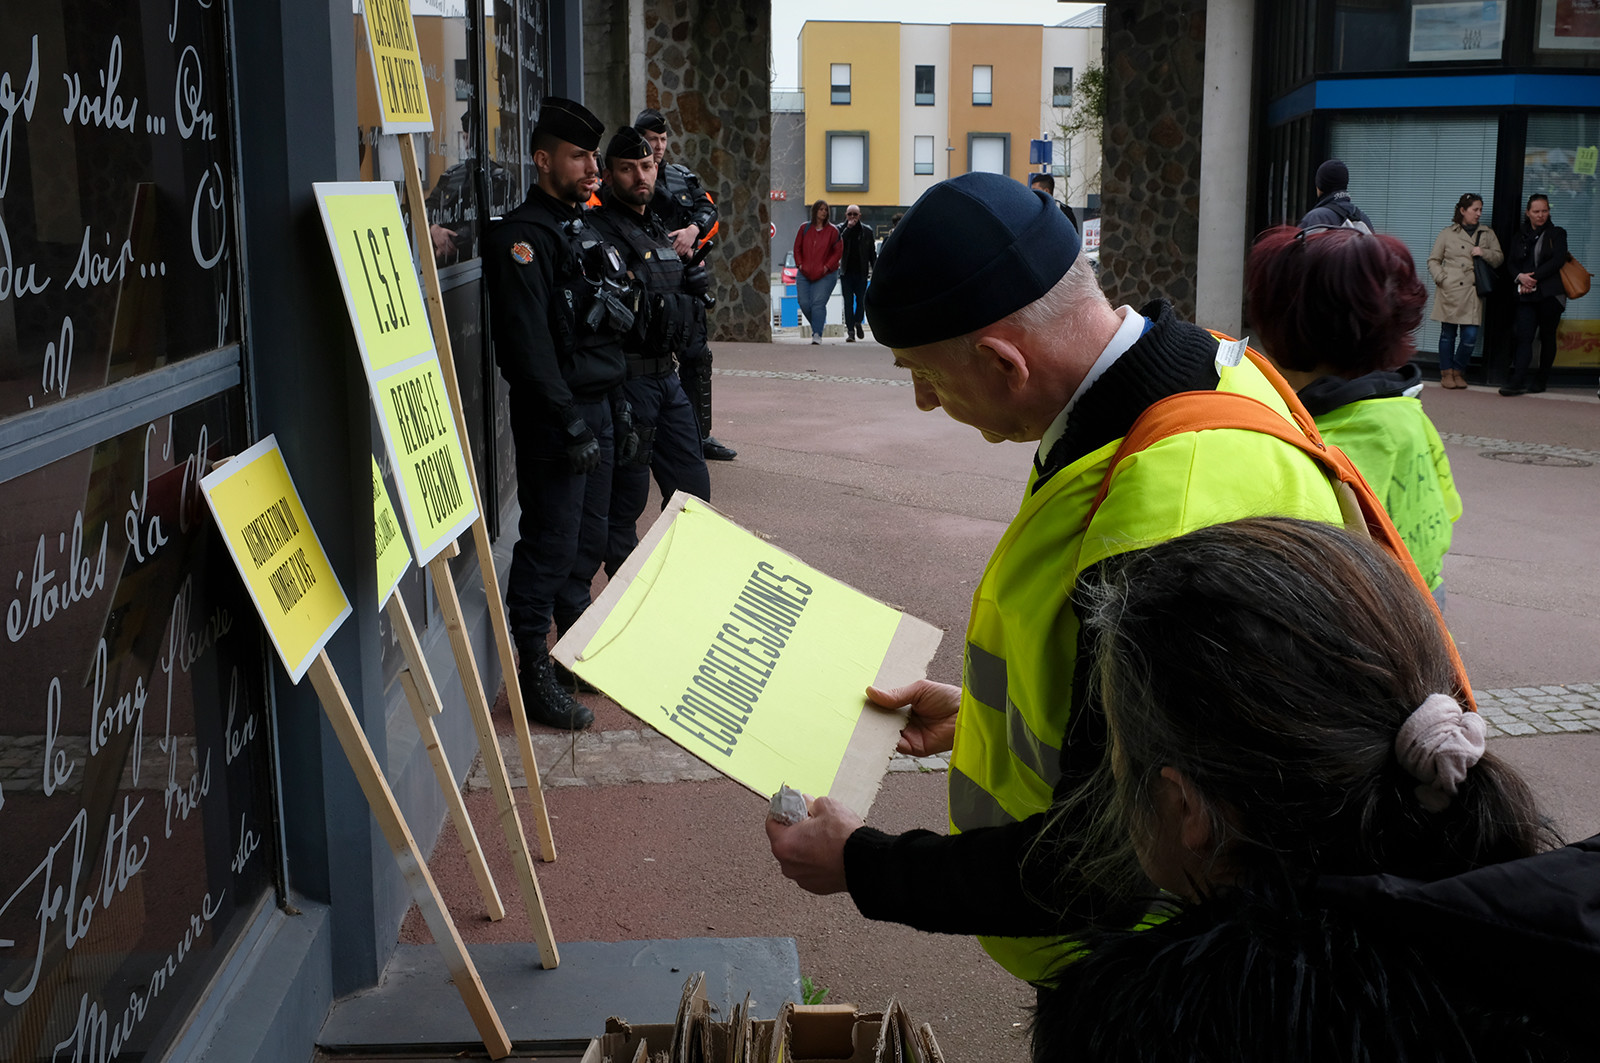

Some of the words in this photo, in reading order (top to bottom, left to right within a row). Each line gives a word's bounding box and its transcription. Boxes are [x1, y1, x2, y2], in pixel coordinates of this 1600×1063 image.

[369, 0, 414, 51] CASTANER
[174, 44, 217, 140] On
[381, 55, 400, 113] EN
[394, 57, 424, 114] ENFER
[352, 226, 412, 335] I.S.F
[390, 385, 434, 455] RENDS
[422, 372, 446, 437] LE
[414, 444, 463, 529] POGNON
[241, 504, 293, 570] AUGMENTATION
[279, 497, 300, 535] DU
[268, 558, 303, 615] NOMBRE
[43, 677, 75, 797] le
[90, 637, 148, 787] long
